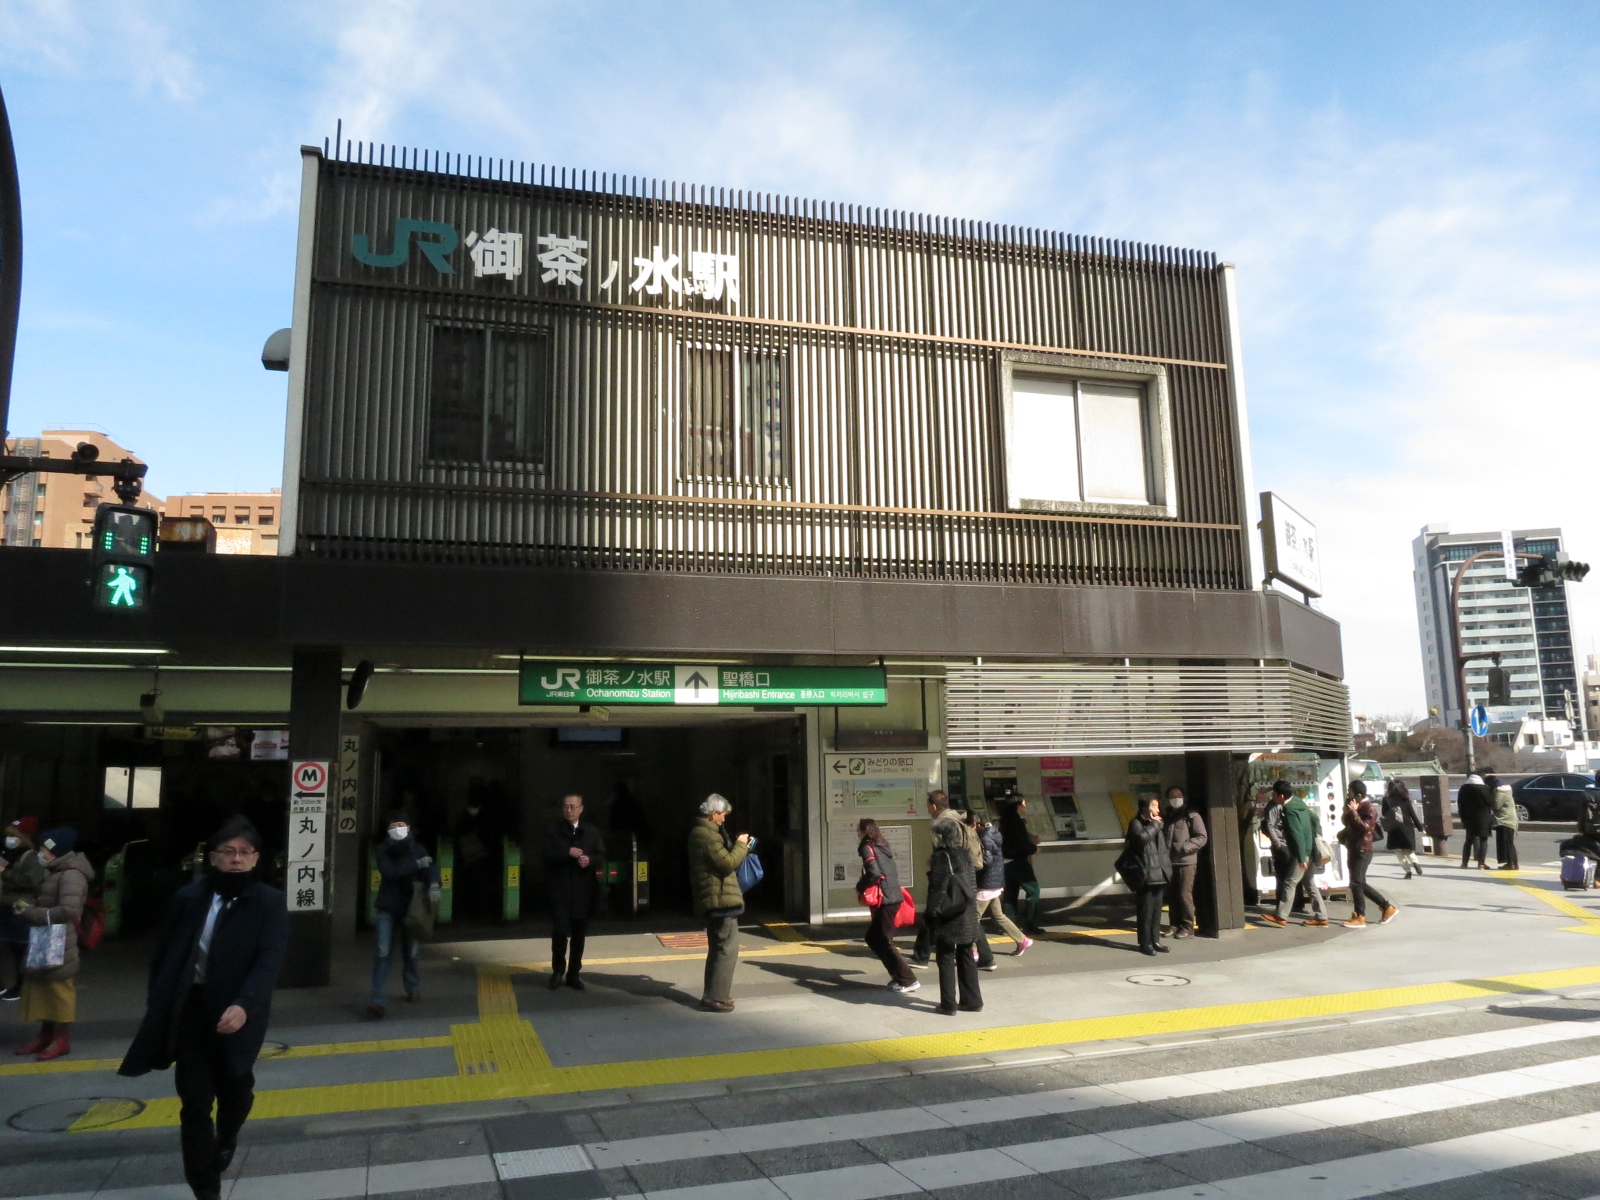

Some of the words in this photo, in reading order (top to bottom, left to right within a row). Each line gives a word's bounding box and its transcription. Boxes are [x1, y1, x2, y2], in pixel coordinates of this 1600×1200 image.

[352, 217, 458, 275] JR
[464, 227, 741, 304] 御茶ノ水駅
[541, 668, 580, 690] JR
[586, 668, 670, 687] 御茶ノ水駅
[722, 671, 770, 687] 聖橋口
[586, 687, 640, 698] Ochanomizu
[641, 688, 671, 698] Station
[722, 690, 760, 701] Hijiribashi
[761, 690, 796, 700] Entrance
[867, 757, 914, 766] みどりの窓口
[301, 769, 318, 782] M
[340, 739, 359, 831] 丸ノ内線の
[296, 816, 318, 908] 丸ノ内線
